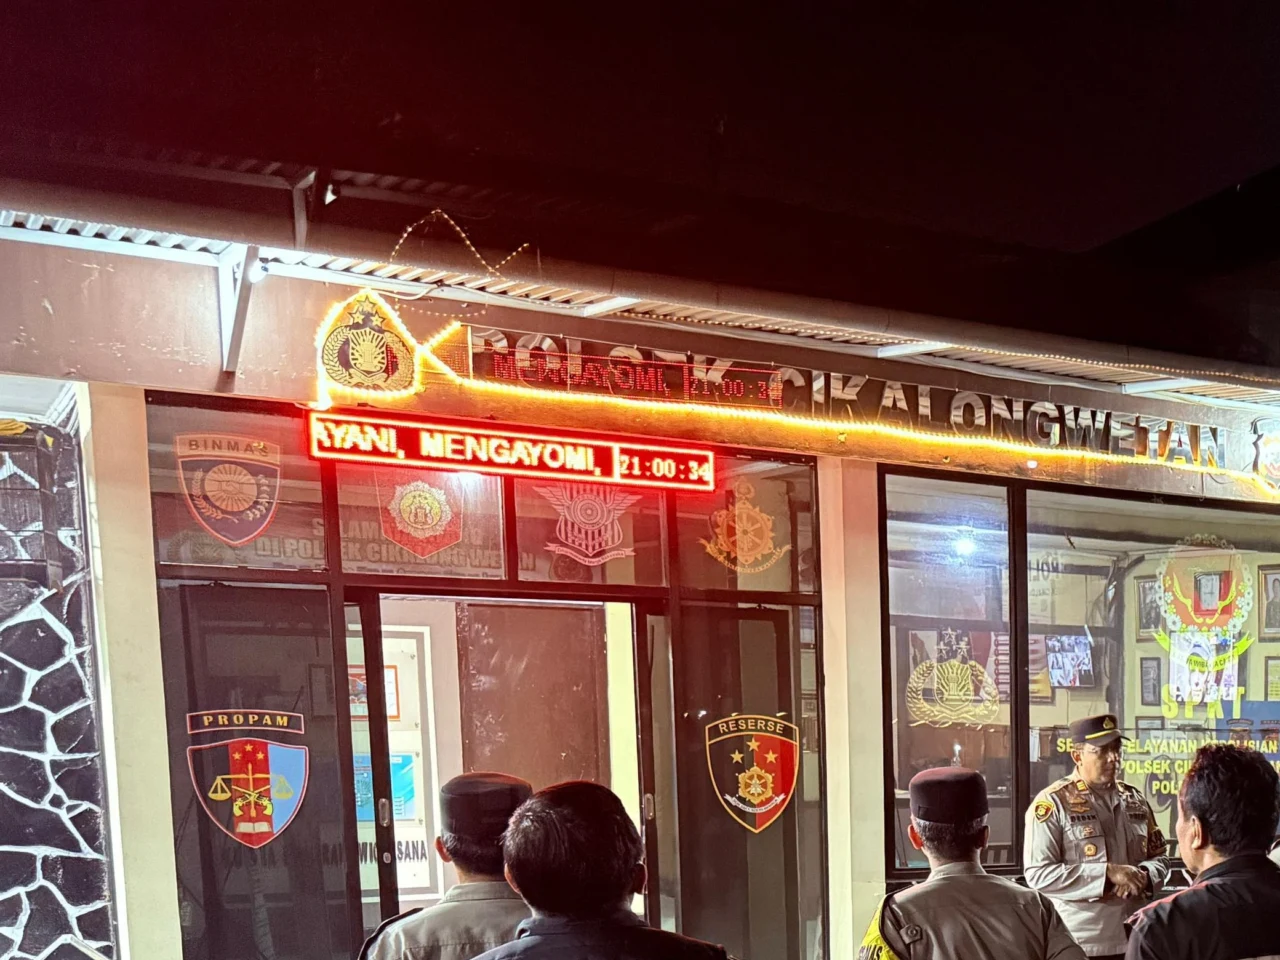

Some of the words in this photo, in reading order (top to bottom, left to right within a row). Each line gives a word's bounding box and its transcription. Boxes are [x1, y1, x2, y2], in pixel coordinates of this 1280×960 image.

[769, 366, 1227, 470] CIKALONGWETAN
[188, 438, 269, 457] BINMAS
[619, 455, 712, 481] 21:00:34
[284, 540, 363, 563] POLEK
[203, 714, 289, 727] PROPAM
[718, 719, 785, 734] RESERSE
[358, 839, 428, 865] WICSANA
